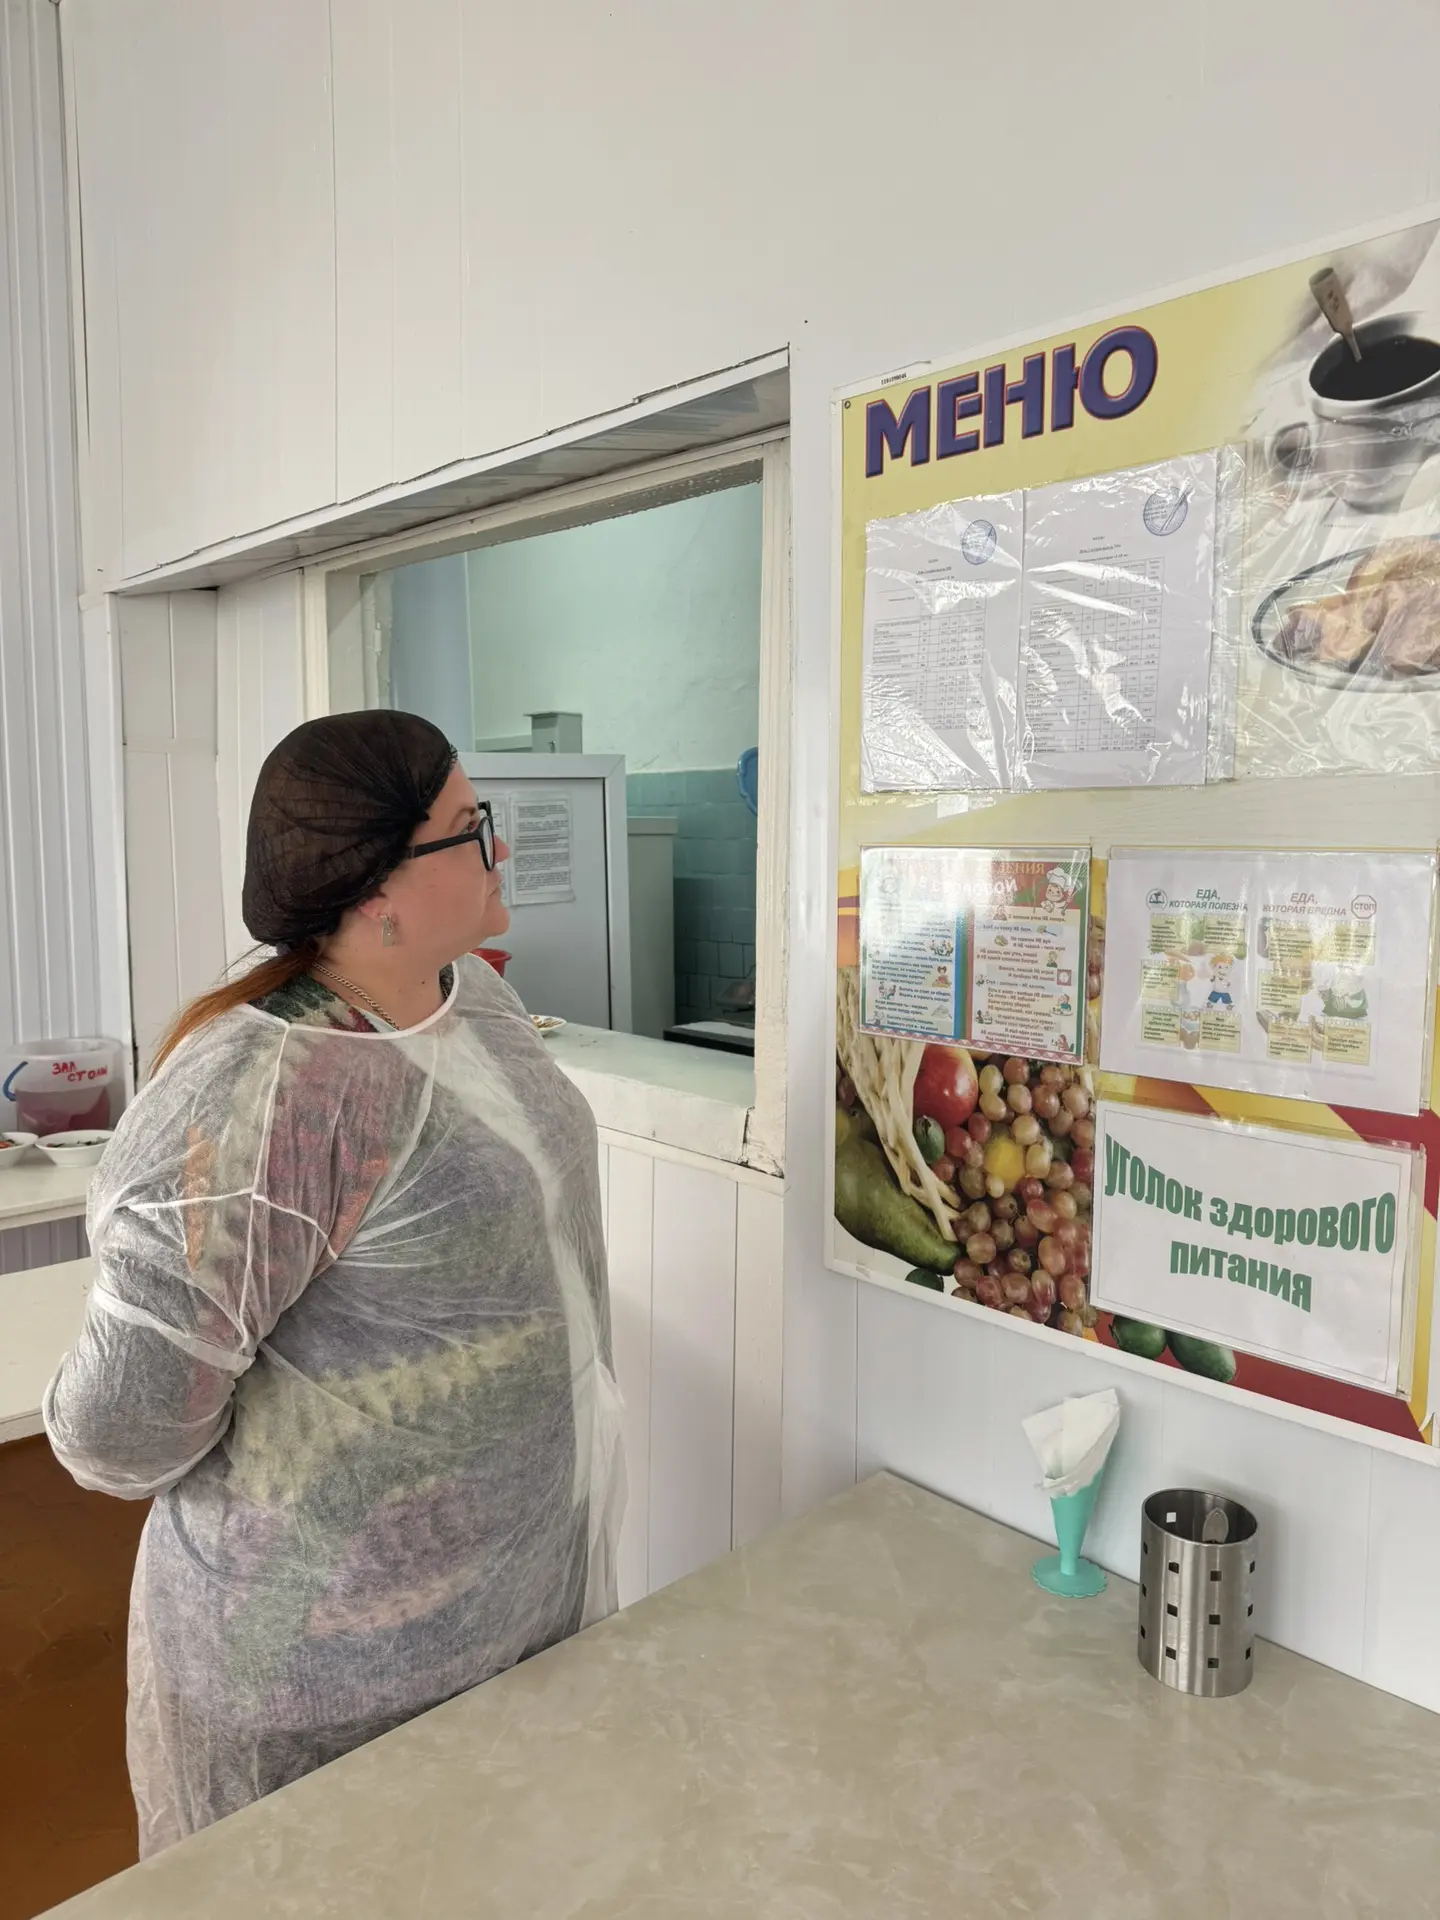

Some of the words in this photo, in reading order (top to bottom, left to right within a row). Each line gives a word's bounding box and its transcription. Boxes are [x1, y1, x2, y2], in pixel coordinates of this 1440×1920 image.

[865, 325, 1158, 478] МЕНЮ
[1196, 889, 1221, 901] ЕДА,
[1290, 892, 1318, 904] ЕДА,
[1169, 900, 1207, 909] КОТОРАЯ
[1208, 901, 1249, 911] ПОЛЕЗНА
[1262, 905, 1306, 914] КОТОРАЯ
[1354, 903, 1375, 911] СТОП
[1209, 1191, 1396, 1254] здорового
[1169, 1240, 1312, 1313] питания
